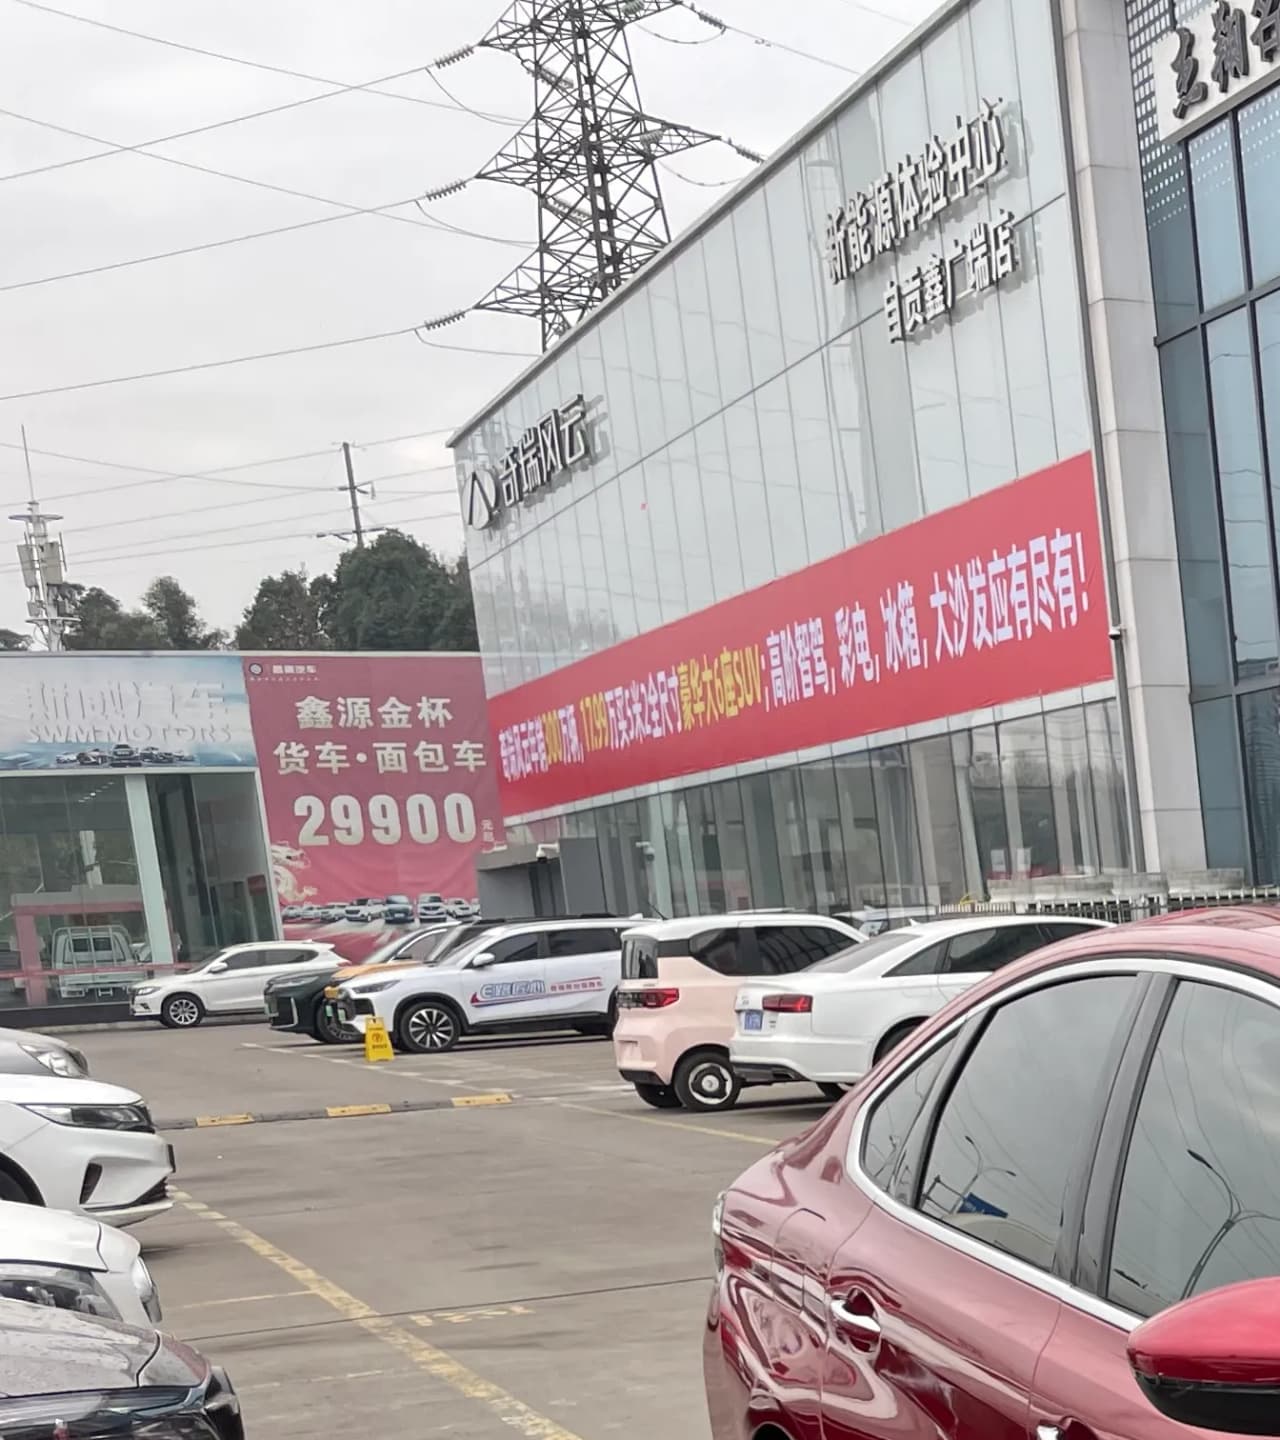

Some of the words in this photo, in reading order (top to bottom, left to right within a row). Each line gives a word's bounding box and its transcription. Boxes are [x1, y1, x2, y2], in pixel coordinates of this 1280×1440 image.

[825, 97, 1007, 285] 新能源体验中心
[883, 208, 1018, 344] 自贡鑫广瑞店
[499, 394, 588, 508] 奇瑞风云
[294, 696, 453, 729] 鑫源金杯
[273, 740, 487, 775] 货车·面包车
[293, 792, 477, 847] 29900
